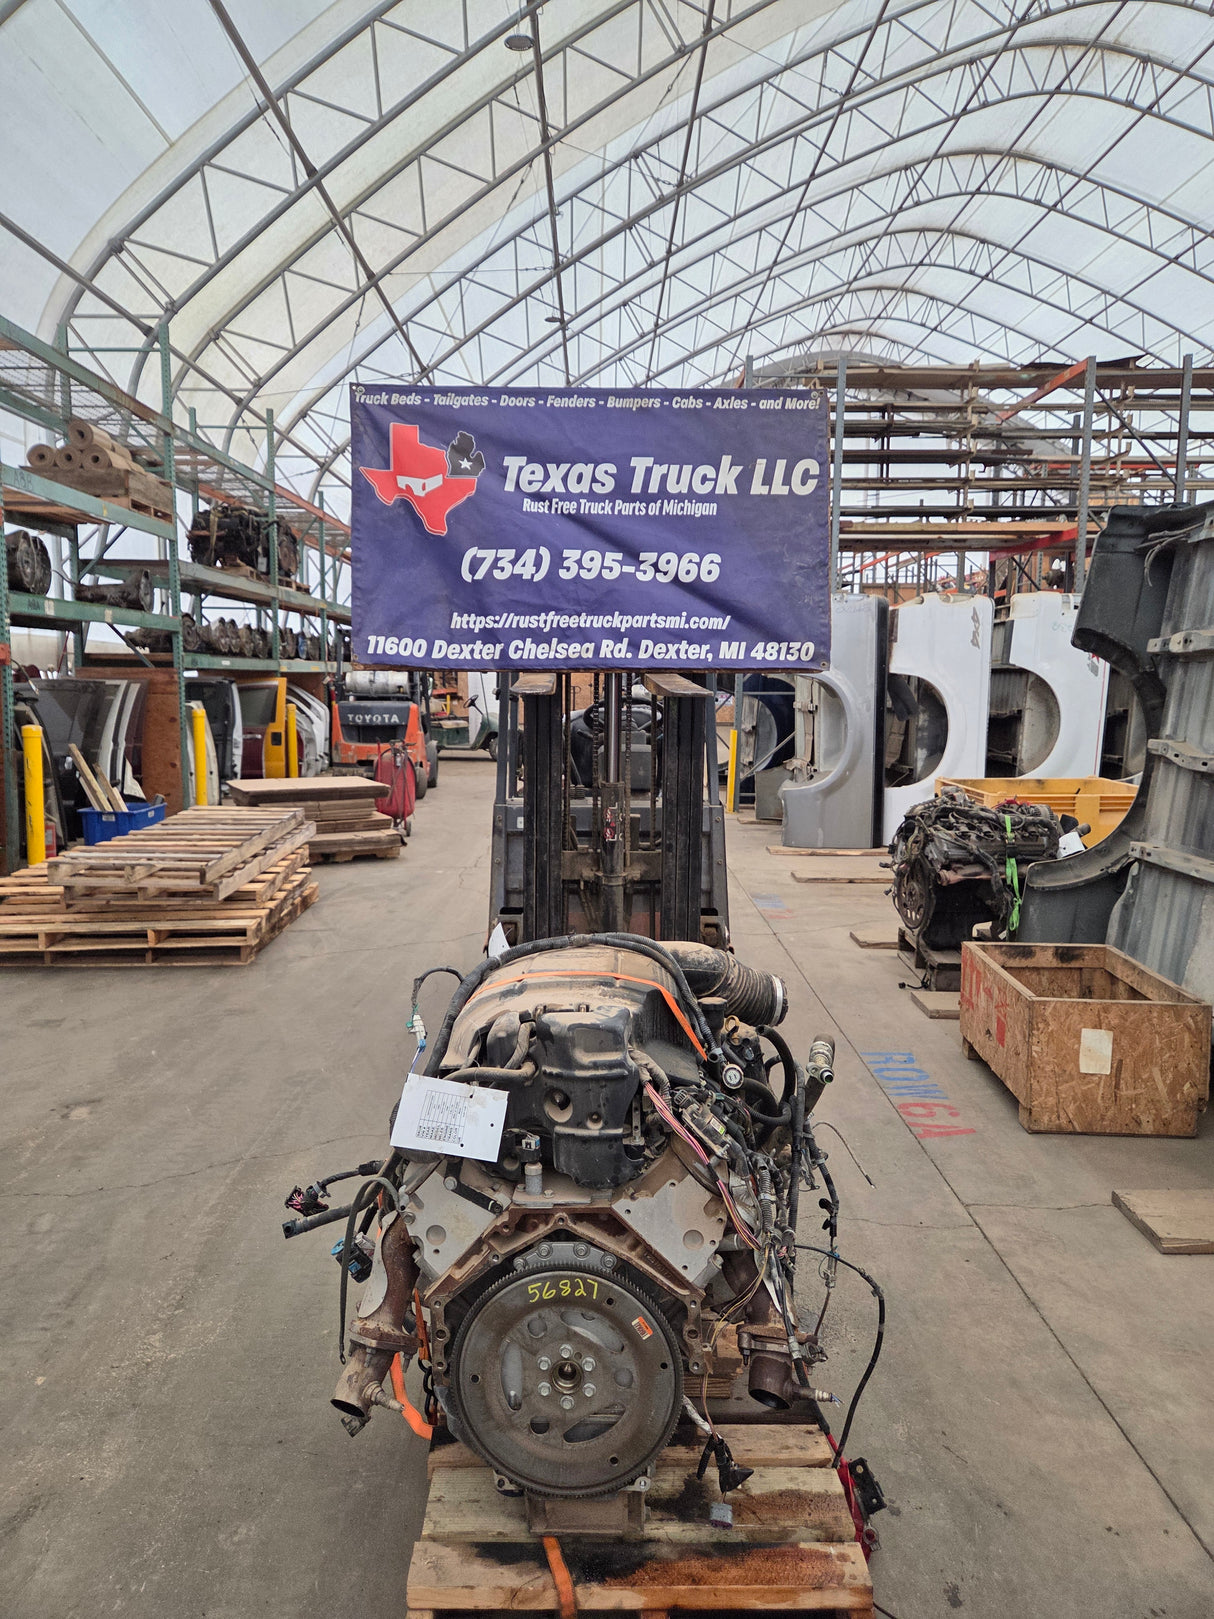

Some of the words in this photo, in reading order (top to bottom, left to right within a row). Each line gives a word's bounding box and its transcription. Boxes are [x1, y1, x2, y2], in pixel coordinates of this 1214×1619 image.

[355, 392, 389, 405] Truck
[391, 393, 421, 405] Beds
[433, 393, 488, 408] Tailgates
[500, 395, 535, 407] Doors
[546, 395, 596, 407] Fenders
[607, 396, 661, 411] Bumpers
[672, 396, 703, 409] Cabs
[713, 397, 748, 409] Axles
[759, 397, 782, 409] and
[785, 398, 821, 410] More!
[502, 456, 617, 494] Texas
[630, 455, 744, 494] Truck
[750, 458, 820, 496] LLC
[523, 498, 550, 513] Rust
[552, 499, 577, 514] Free
[580, 499, 613, 514] Truck
[615, 500, 646, 515] Parts
[648, 500, 661, 516] of
[663, 500, 717, 517] Michigan
[461, 546, 551, 583] (734)
[558, 549, 722, 583] 395-3966
[450, 611, 731, 632] https://rustfreetruckpartsmi.com/
[367, 635, 427, 658] 11600
[432, 639, 503, 660] Dexter
[508, 637, 594, 660] Chelsea
[600, 638, 632, 659] Rd.
[638, 640, 713, 662] Dexter,
[719, 641, 746, 660] MI
[750, 641, 815, 662] 48130
[347, 714, 400, 723] TOYOTA
[860, 1052, 949, 1099] ROW
[528, 1279, 598, 1302] 56827
